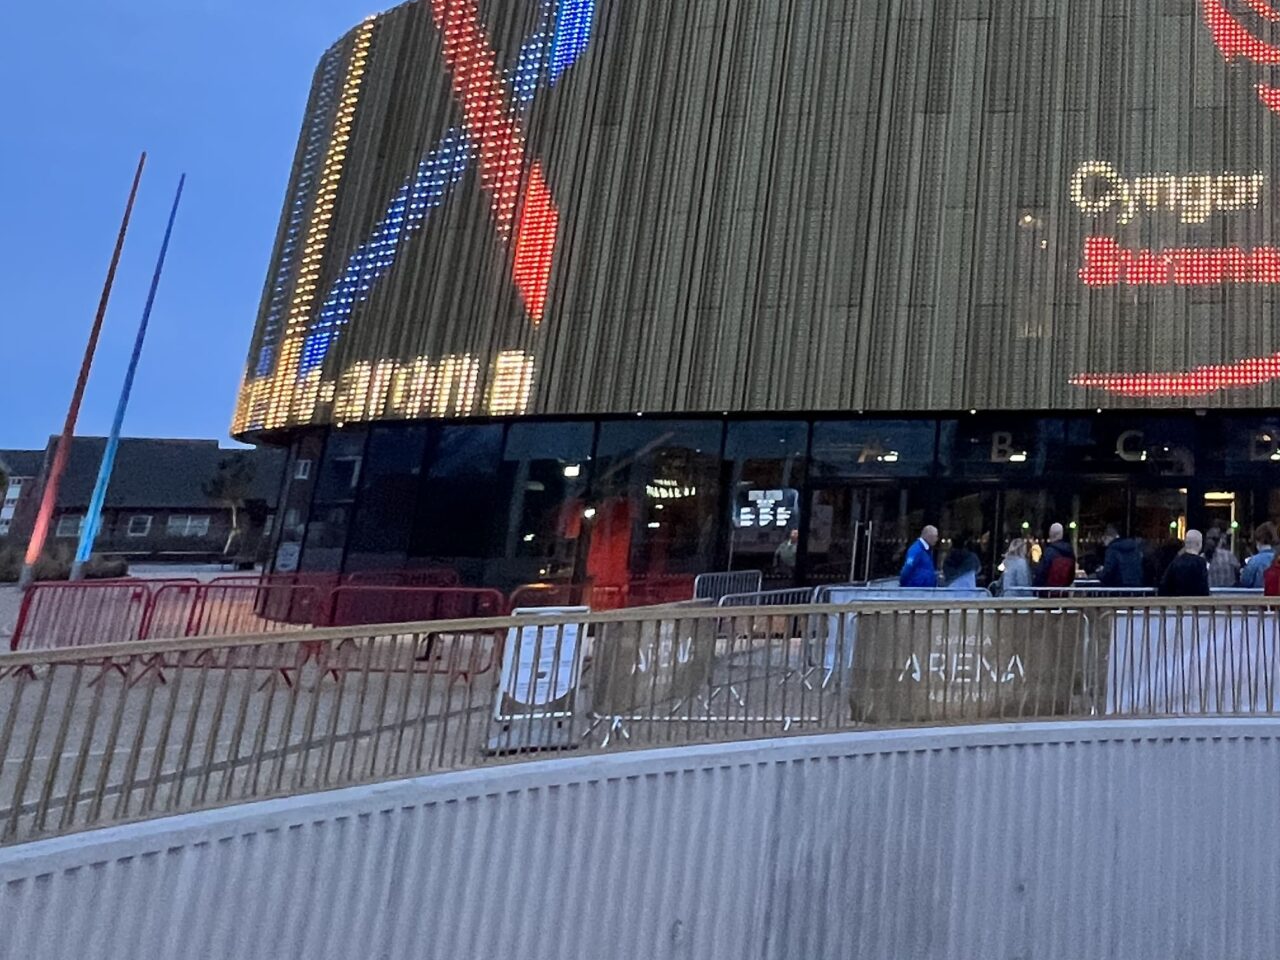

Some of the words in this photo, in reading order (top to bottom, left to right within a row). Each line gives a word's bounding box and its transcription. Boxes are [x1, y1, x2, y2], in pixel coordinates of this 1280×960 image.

[1070, 159, 1265, 226] Cyngor
[990, 431, 1016, 463] B
[1116, 430, 1145, 462] C
[898, 653, 1026, 683] ARENA
